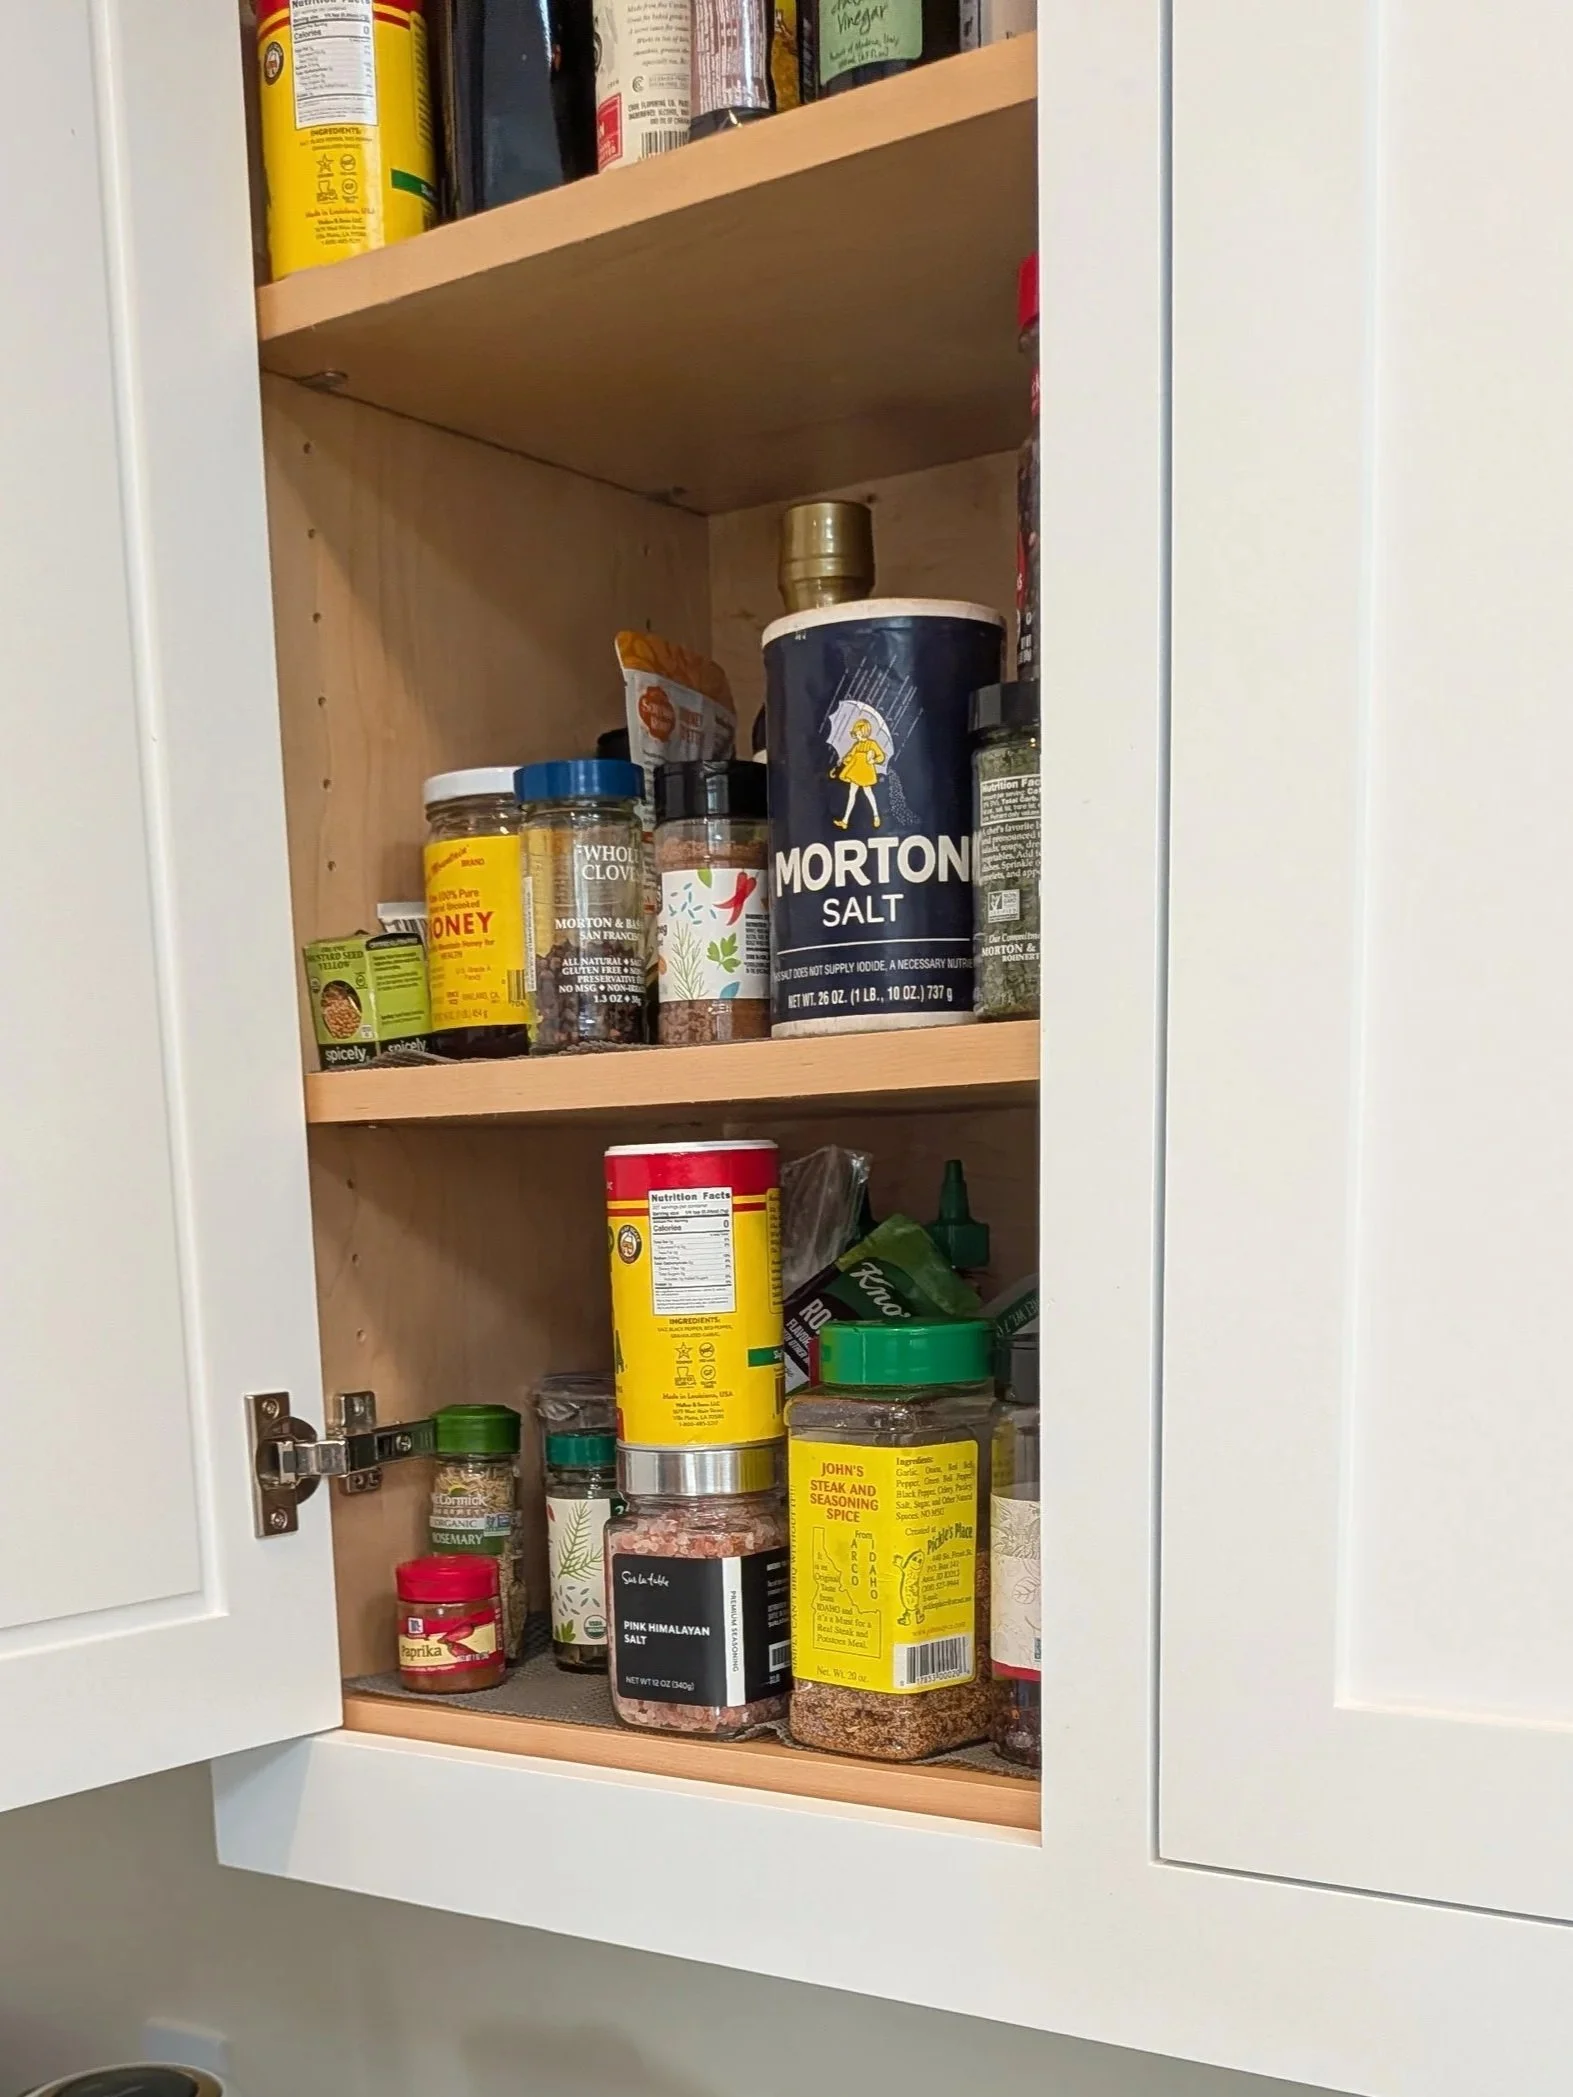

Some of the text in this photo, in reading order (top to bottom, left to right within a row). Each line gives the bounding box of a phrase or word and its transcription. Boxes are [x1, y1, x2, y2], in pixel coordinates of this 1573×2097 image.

[582, 845, 640, 863] WHOL
[582, 864, 638, 881] CLOV
[775, 834, 971, 898] MORTON
[823, 894, 904, 928] SALT
[430, 911, 494, 939] ONEY
[554, 917, 625, 930] MORTON &
[342, 950, 365, 960] SEED
[981, 943, 1036, 957] MORTON &
[562, 957, 623, 968] ALL NATURAL
[810, 963, 824, 976] NOT
[824, 961, 856, 975] SUPPLY
[856, 959, 888, 972] IODIDE,
[889, 959, 897, 971] A
[897, 957, 946, 970] NECESSARY
[947, 957, 974, 969] NUTRIE
[561, 967, 622, 977] GLUTEN FREE
[558, 985, 574, 995] NO
[788, 995, 803, 1009] NET
[803, 993, 818, 1008] WT.
[818, 991, 830, 1006] 26
[831, 991, 849, 1005] OZ.
[887, 986, 900, 1001] 10
[926, 985, 945, 1001] 737
[946, 988, 954, 1003] g
[651, 1191, 731, 1202] Nutrition Facts
[653, 1224, 683, 1232] Calories
[723, 1219, 730, 1229] 0
[850, 1261, 912, 1320] Kno
[799, 1297, 833, 1335] RO
[720, 1390, 734, 1398] USA
[821, 1462, 865, 1478] JOHN'S
[810, 1479, 878, 1498] STEAK AND
[810, 1492, 880, 1512] SEASONING
[826, 1507, 861, 1524] SPICE
[855, 1530, 874, 1541] From
[953, 1521, 973, 1540] Place
[850, 1539, 861, 1588] ARCO
[868, 1539, 880, 1601] IDAHO
[816, 1602, 841, 1614] IDAHO
[623, 1620, 711, 1637] PINK HIMALAYAN
[730, 1589, 740, 1673] PREMIUM SEASONING
[855, 1629, 870, 1639] and
[623, 1633, 648, 1645] SALT
[401, 1644, 443, 1661] Paprika
[625, 1675, 640, 1686] NET
[640, 1677, 652, 1687] WT
[652, 1678, 659, 1687] 12
[659, 1679, 671, 1689] OZ
